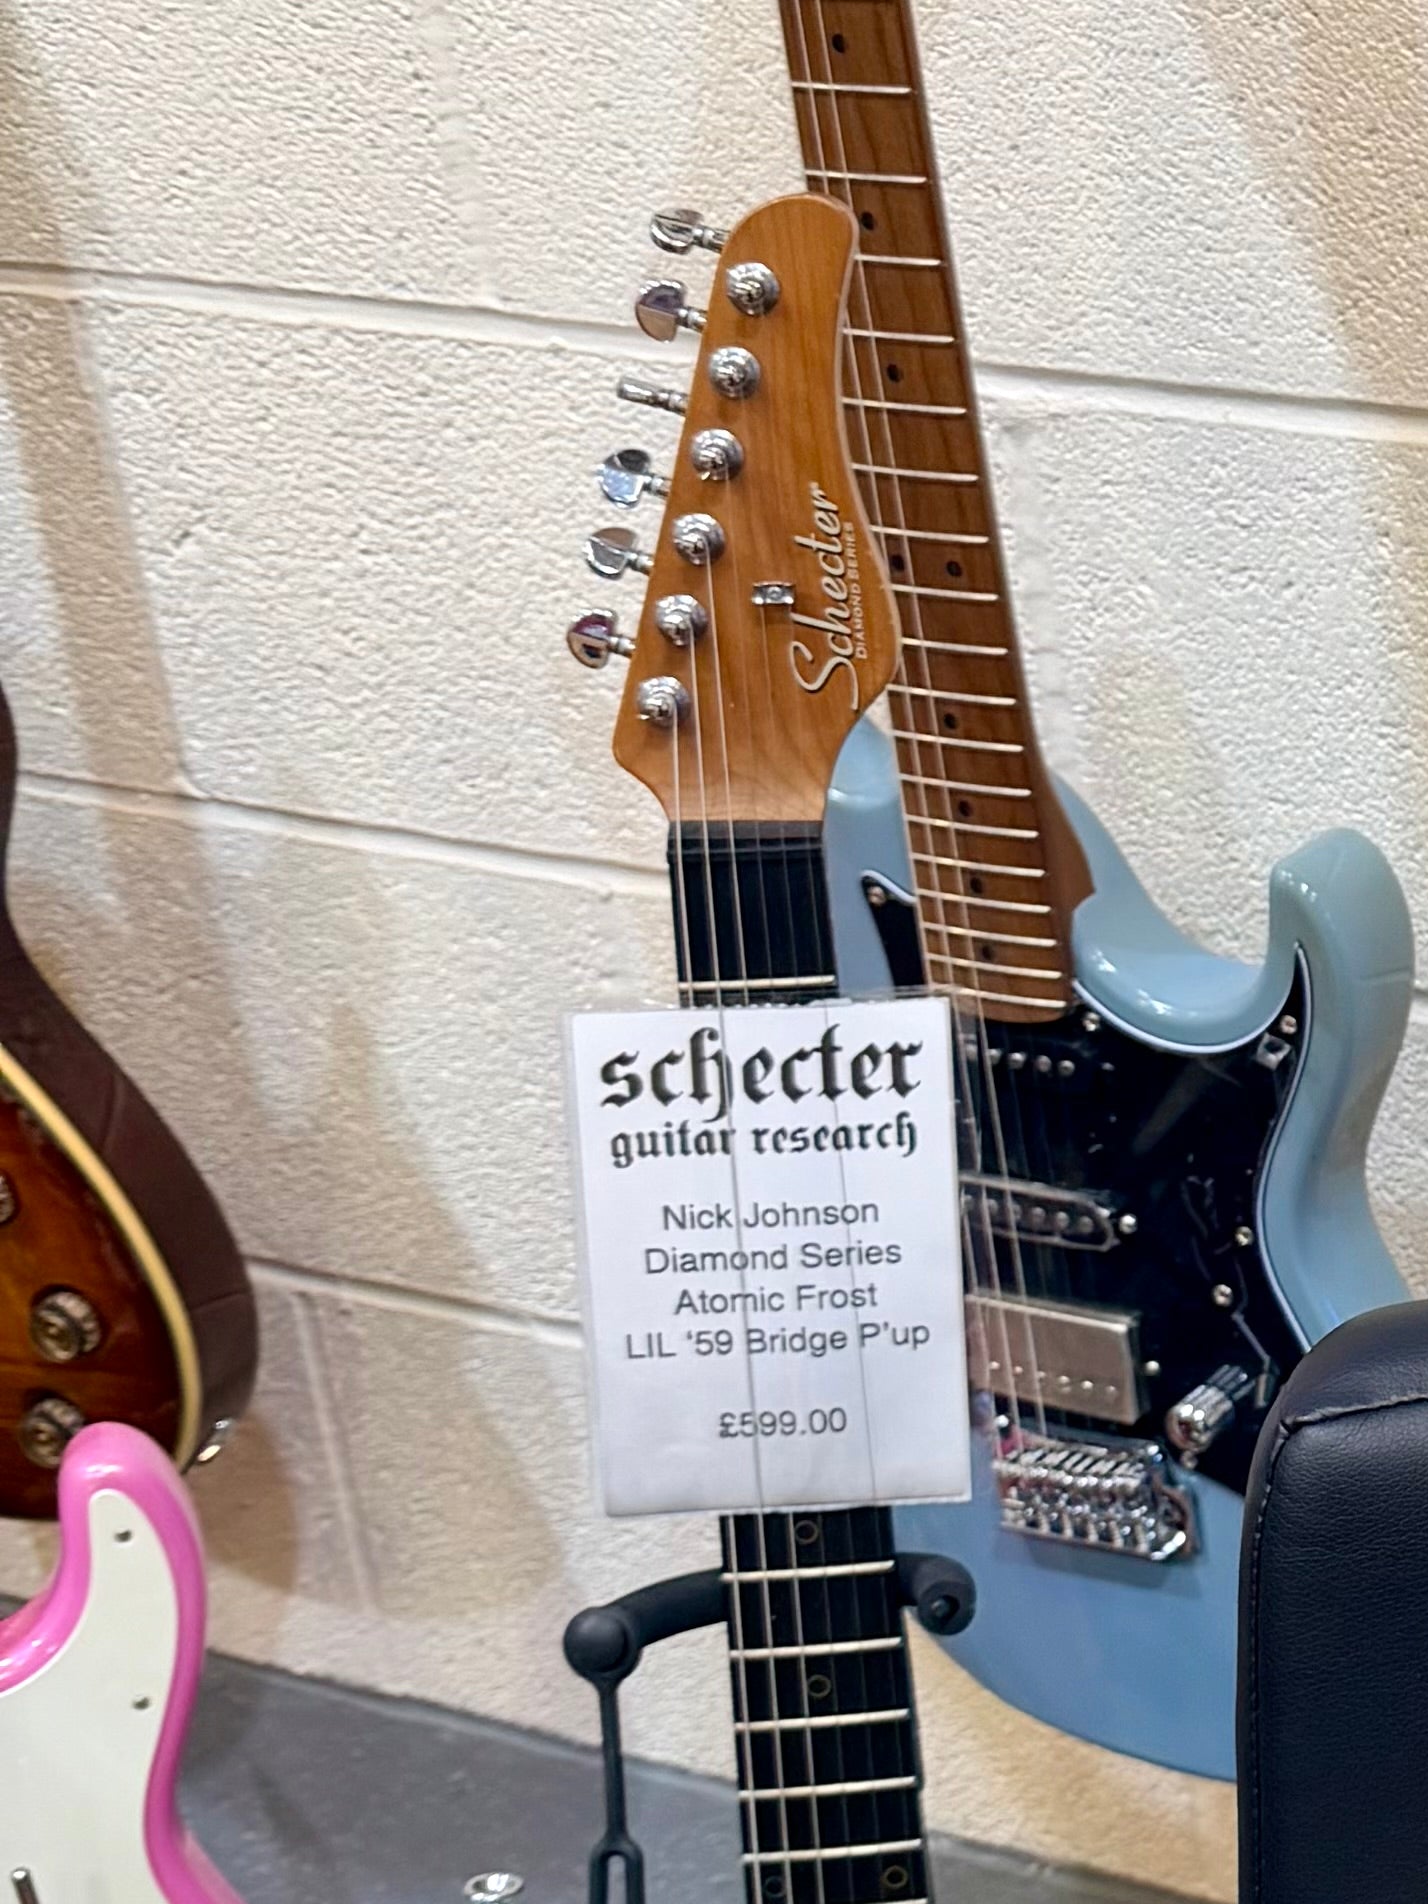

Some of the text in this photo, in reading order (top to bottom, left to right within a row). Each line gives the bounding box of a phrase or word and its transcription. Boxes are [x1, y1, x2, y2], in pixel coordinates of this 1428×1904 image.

[789, 481, 859, 710] Schecter
[600, 1022, 924, 1122] schecter
[610, 1110, 918, 1169] guitar research
[663, 1202, 880, 1230] Nick Johnson
[645, 1241, 902, 1275] Diamond Series
[674, 1282, 878, 1317] Atomic Frost
[626, 1332, 676, 1360] LIL
[747, 1327, 848, 1358] Bridge
[719, 1407, 848, 1440] £599.00
